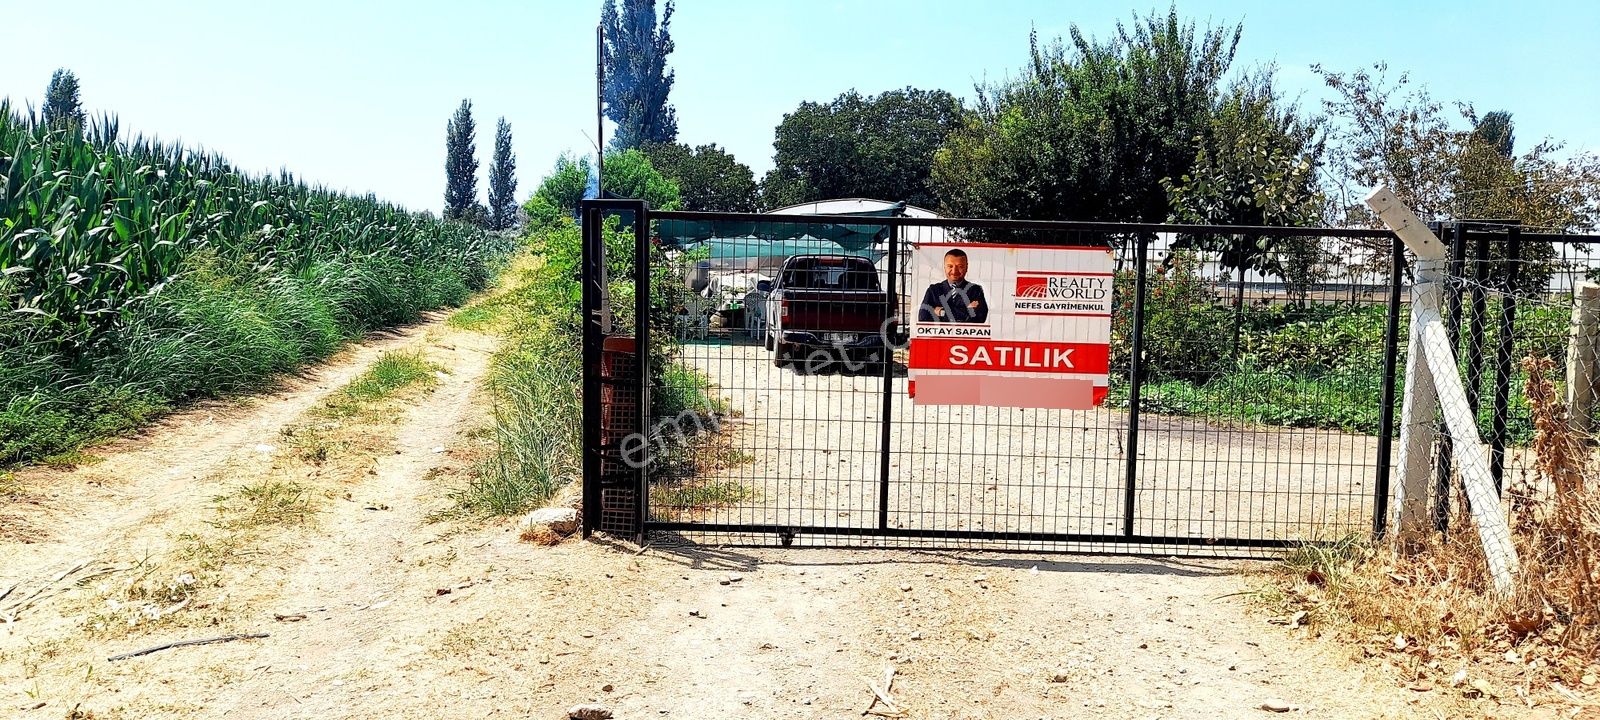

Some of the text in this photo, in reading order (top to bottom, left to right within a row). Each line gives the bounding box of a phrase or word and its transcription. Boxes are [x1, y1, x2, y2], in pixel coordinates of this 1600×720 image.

[1049, 277, 1106, 288] REALTY
[1048, 288, 1106, 299] WORLD
[1043, 302, 1105, 311] GAYRİMENKUL
[917, 327, 991, 336] OKTAY SAPAN
[949, 345, 1075, 368] SATILIK
